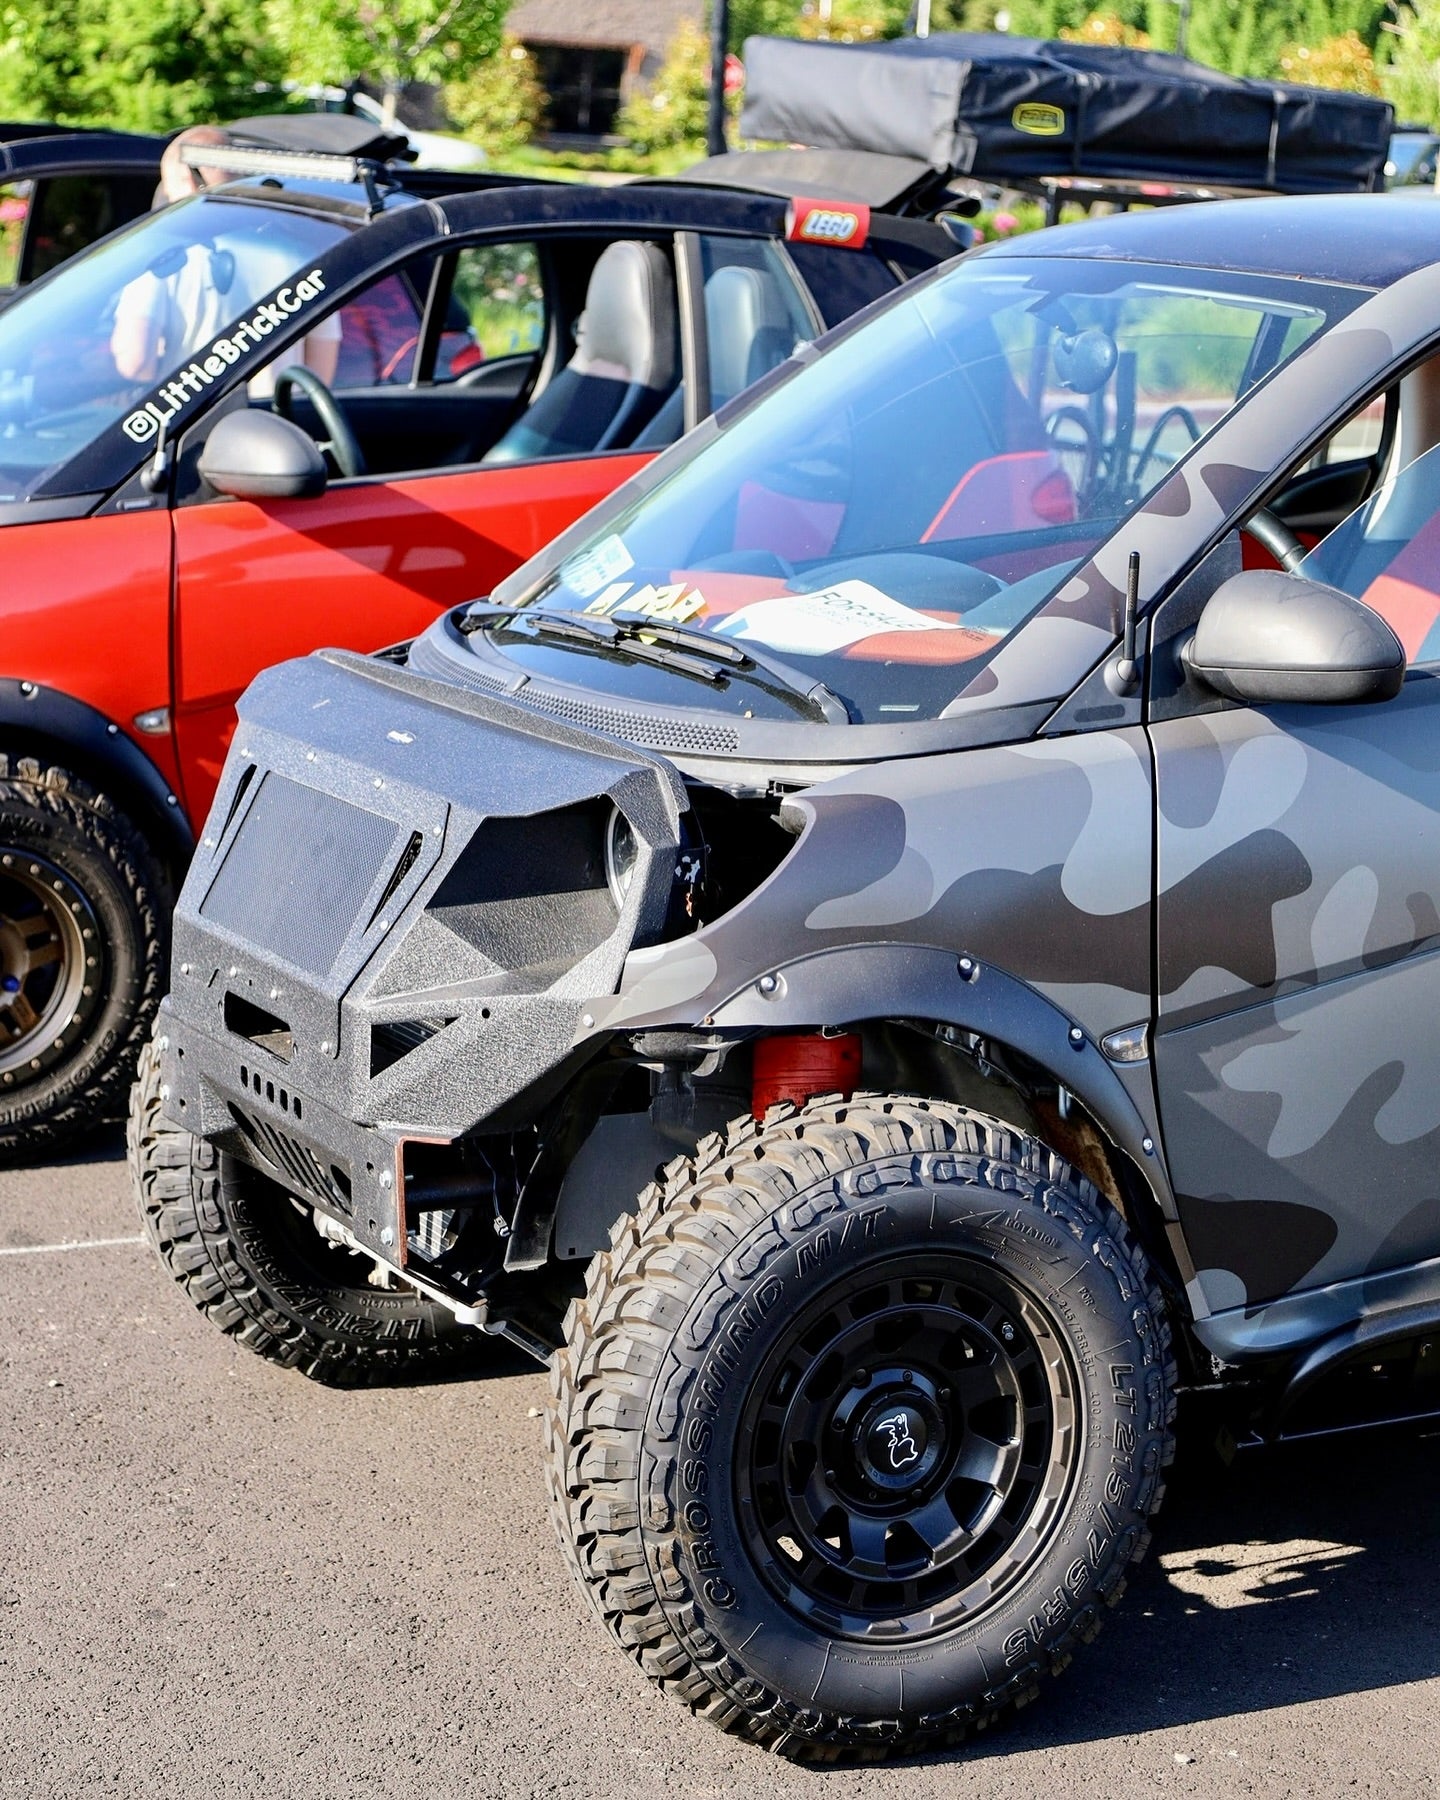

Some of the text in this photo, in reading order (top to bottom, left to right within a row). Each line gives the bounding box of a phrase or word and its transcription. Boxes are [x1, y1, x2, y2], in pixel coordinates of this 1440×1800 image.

[804, 211, 856, 238] LEGO
[1005, 1216, 1060, 1249] ROTATION
[376, 1317, 424, 1340] LT
[682, 1273, 785, 1609] CROSSWIND
[795, 1204, 888, 1278] M/T
[1001, 1362, 1138, 1668] LT 215/75R15
